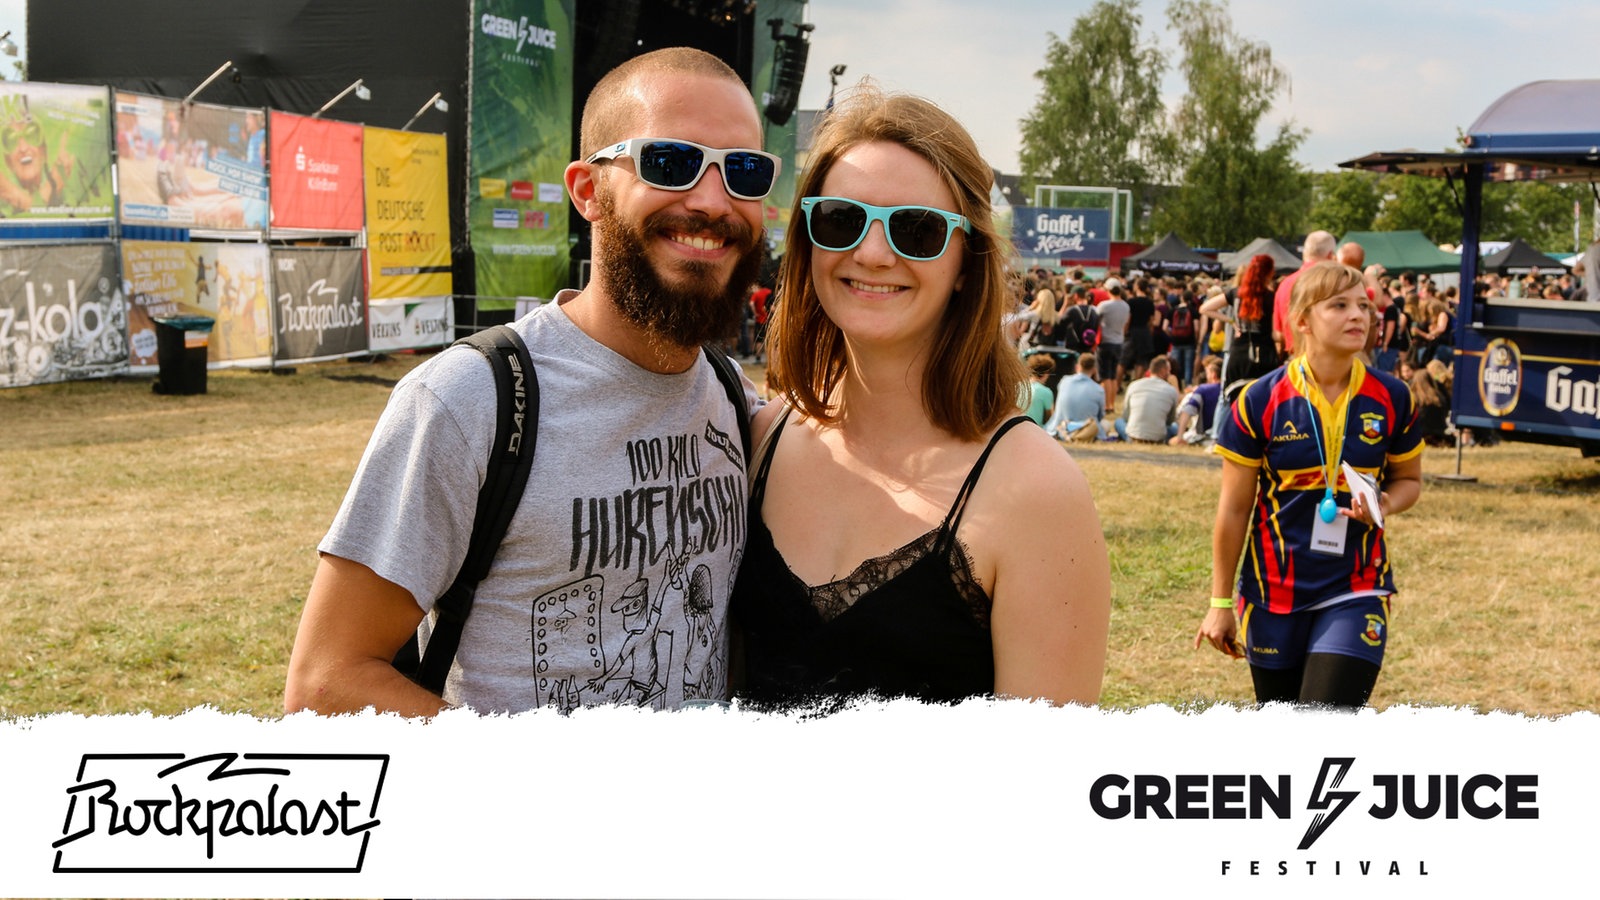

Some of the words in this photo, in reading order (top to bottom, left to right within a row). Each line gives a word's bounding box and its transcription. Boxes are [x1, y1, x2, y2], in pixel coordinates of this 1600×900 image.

[481, 13, 518, 40] GREEN
[527, 24, 556, 50] JUICE
[375, 166, 391, 188] DIE
[377, 199, 426, 221] DEUTSCHE
[1036, 213, 1086, 234] Gaffel
[379, 232, 402, 253] POST
[277, 291, 364, 346] Rockpalast
[421, 317, 449, 334] VELTINS
[371, 321, 401, 338] VELTINS
[1484, 367, 1518, 386] Gaffel
[508, 352, 526, 457] DAKINE
[1272, 432, 1310, 442] AKUMA
[625, 439, 663, 487] 100
[667, 433, 701, 497] KILO
[569, 474, 746, 581] HURENSOHN
[1252, 646, 1279, 655] AKUMA
